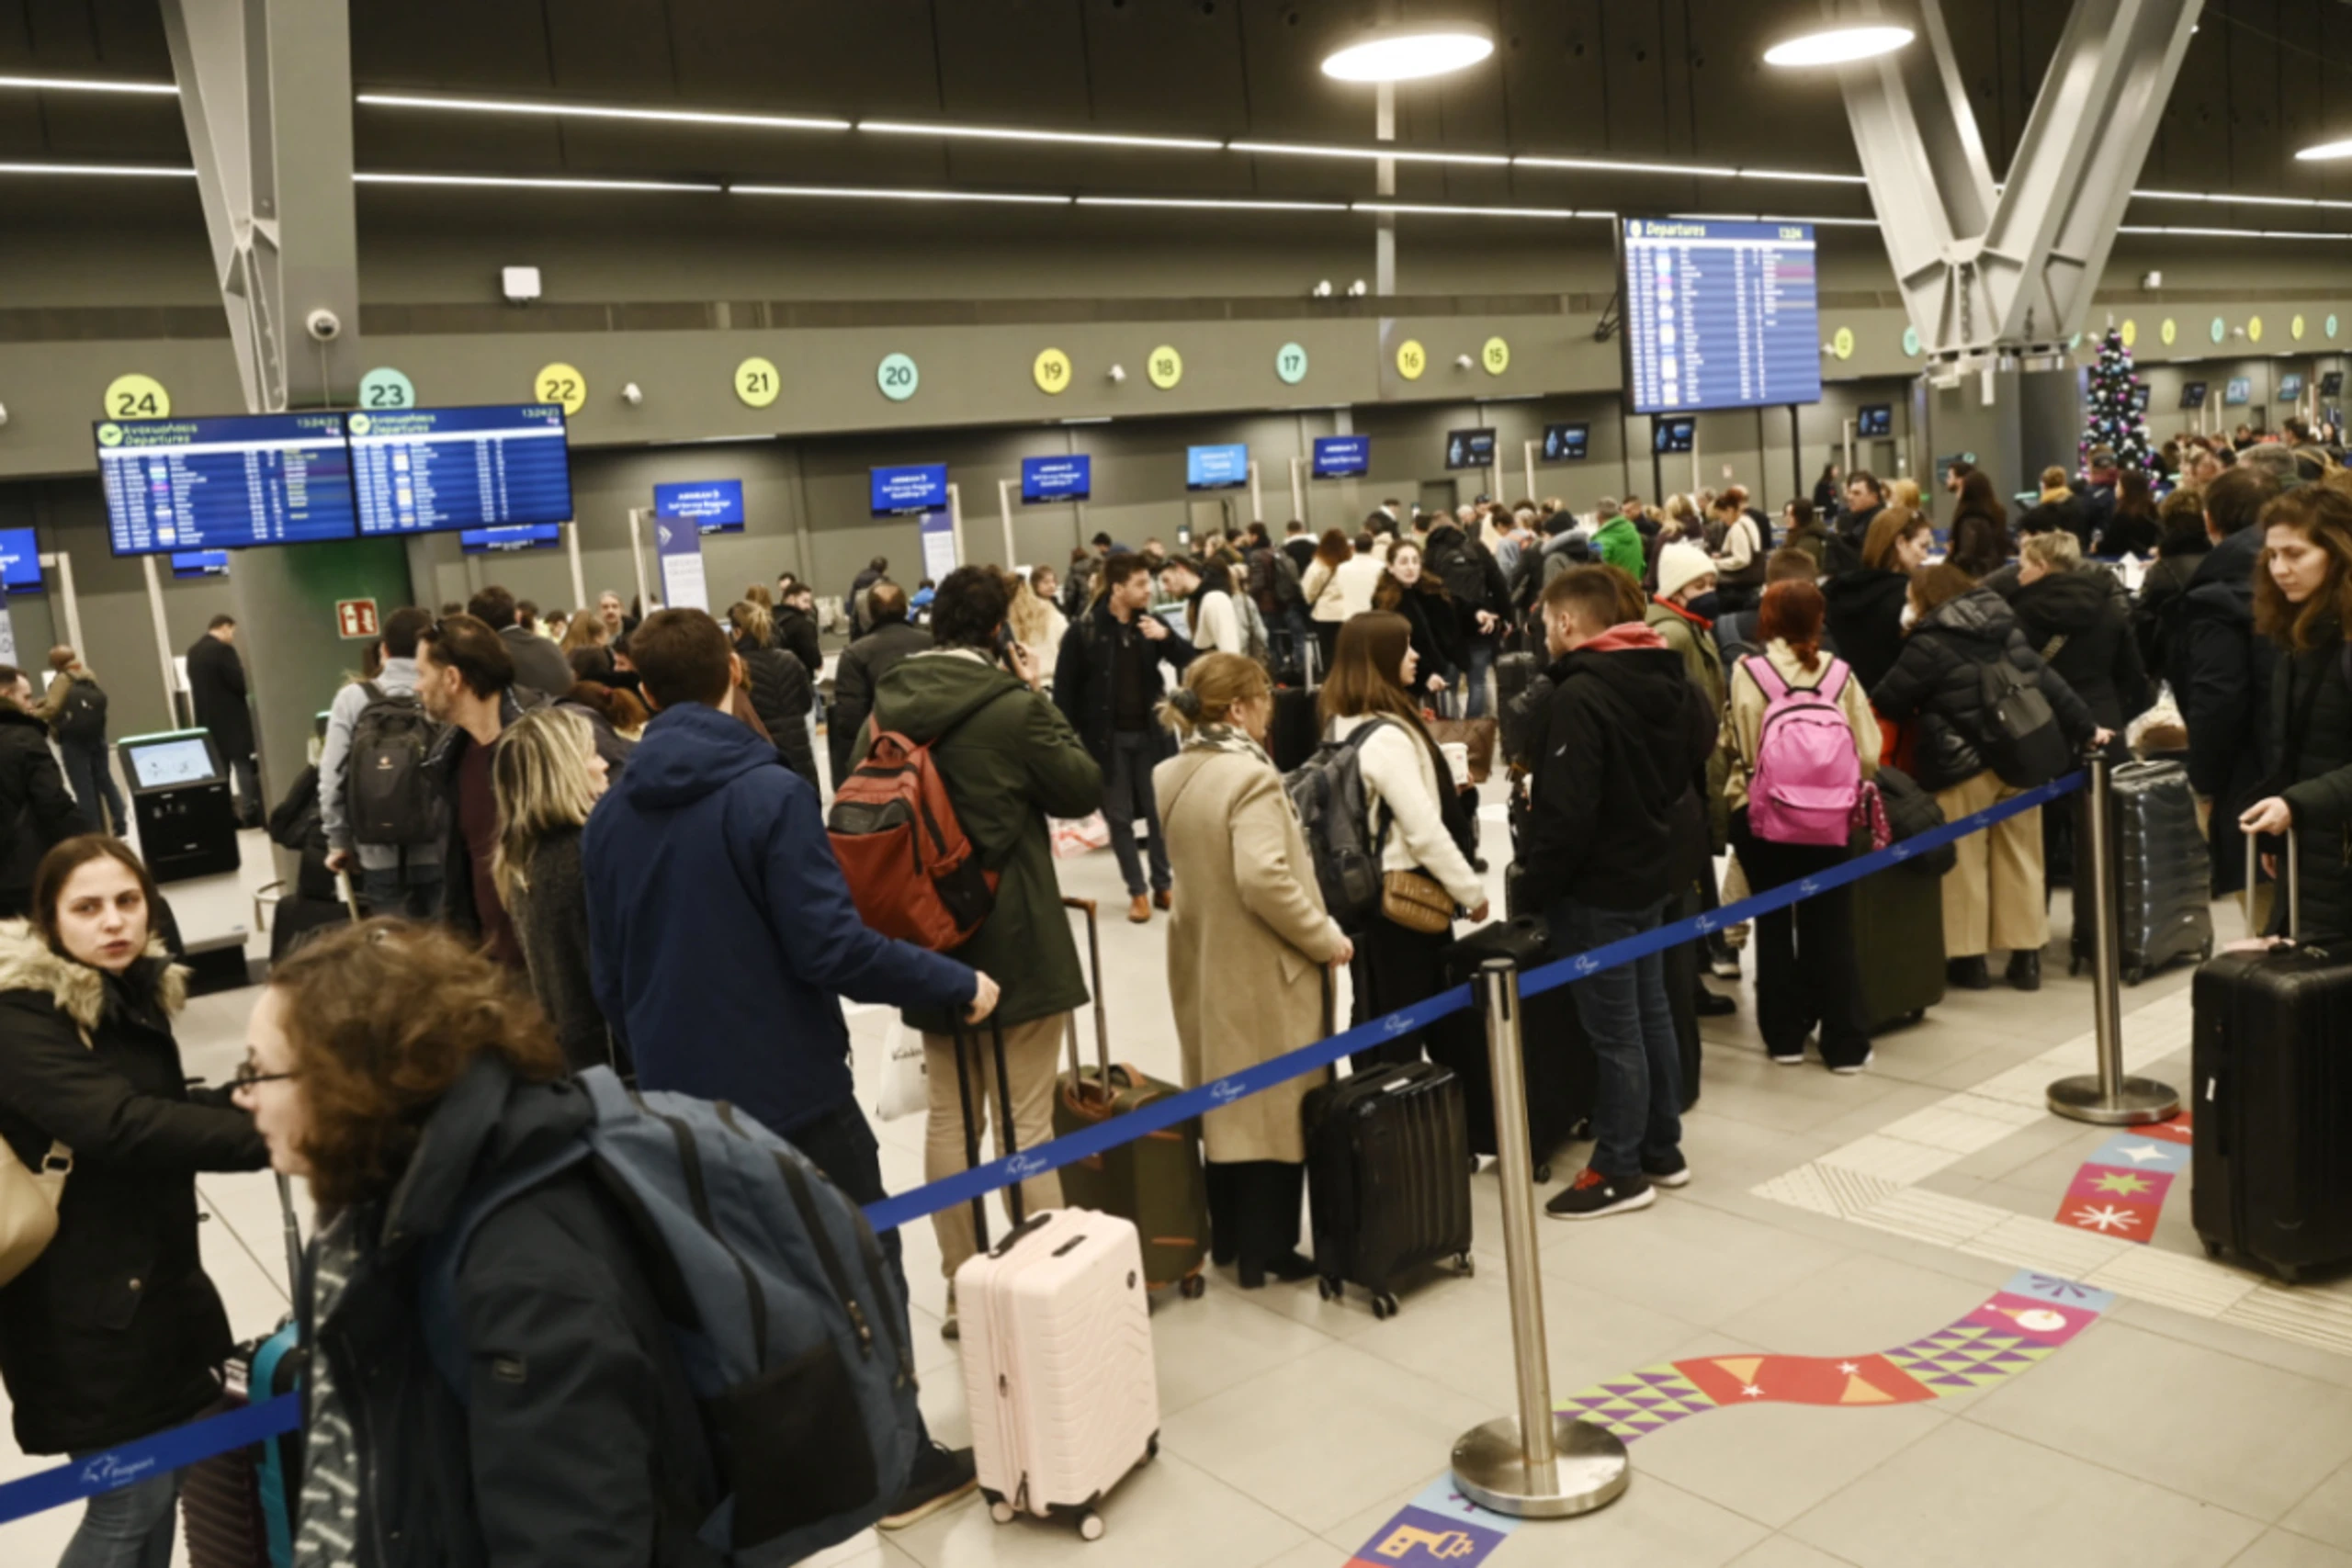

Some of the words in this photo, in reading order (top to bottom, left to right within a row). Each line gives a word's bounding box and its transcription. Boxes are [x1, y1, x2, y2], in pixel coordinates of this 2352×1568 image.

[1645, 222, 1705, 238] Departures
[1283, 355, 1300, 371] 17
[1404, 352, 1419, 368] 16
[1489, 347, 1503, 365] 15
[885, 366, 911, 386] 20
[1043, 361, 1062, 380] 19
[1156, 358, 1175, 377] 18
[545, 378, 577, 401] 22
[746, 372, 769, 393] 21
[118, 392, 158, 416] 24
[369, 384, 404, 407] 23
[125, 434, 191, 447] Departures
